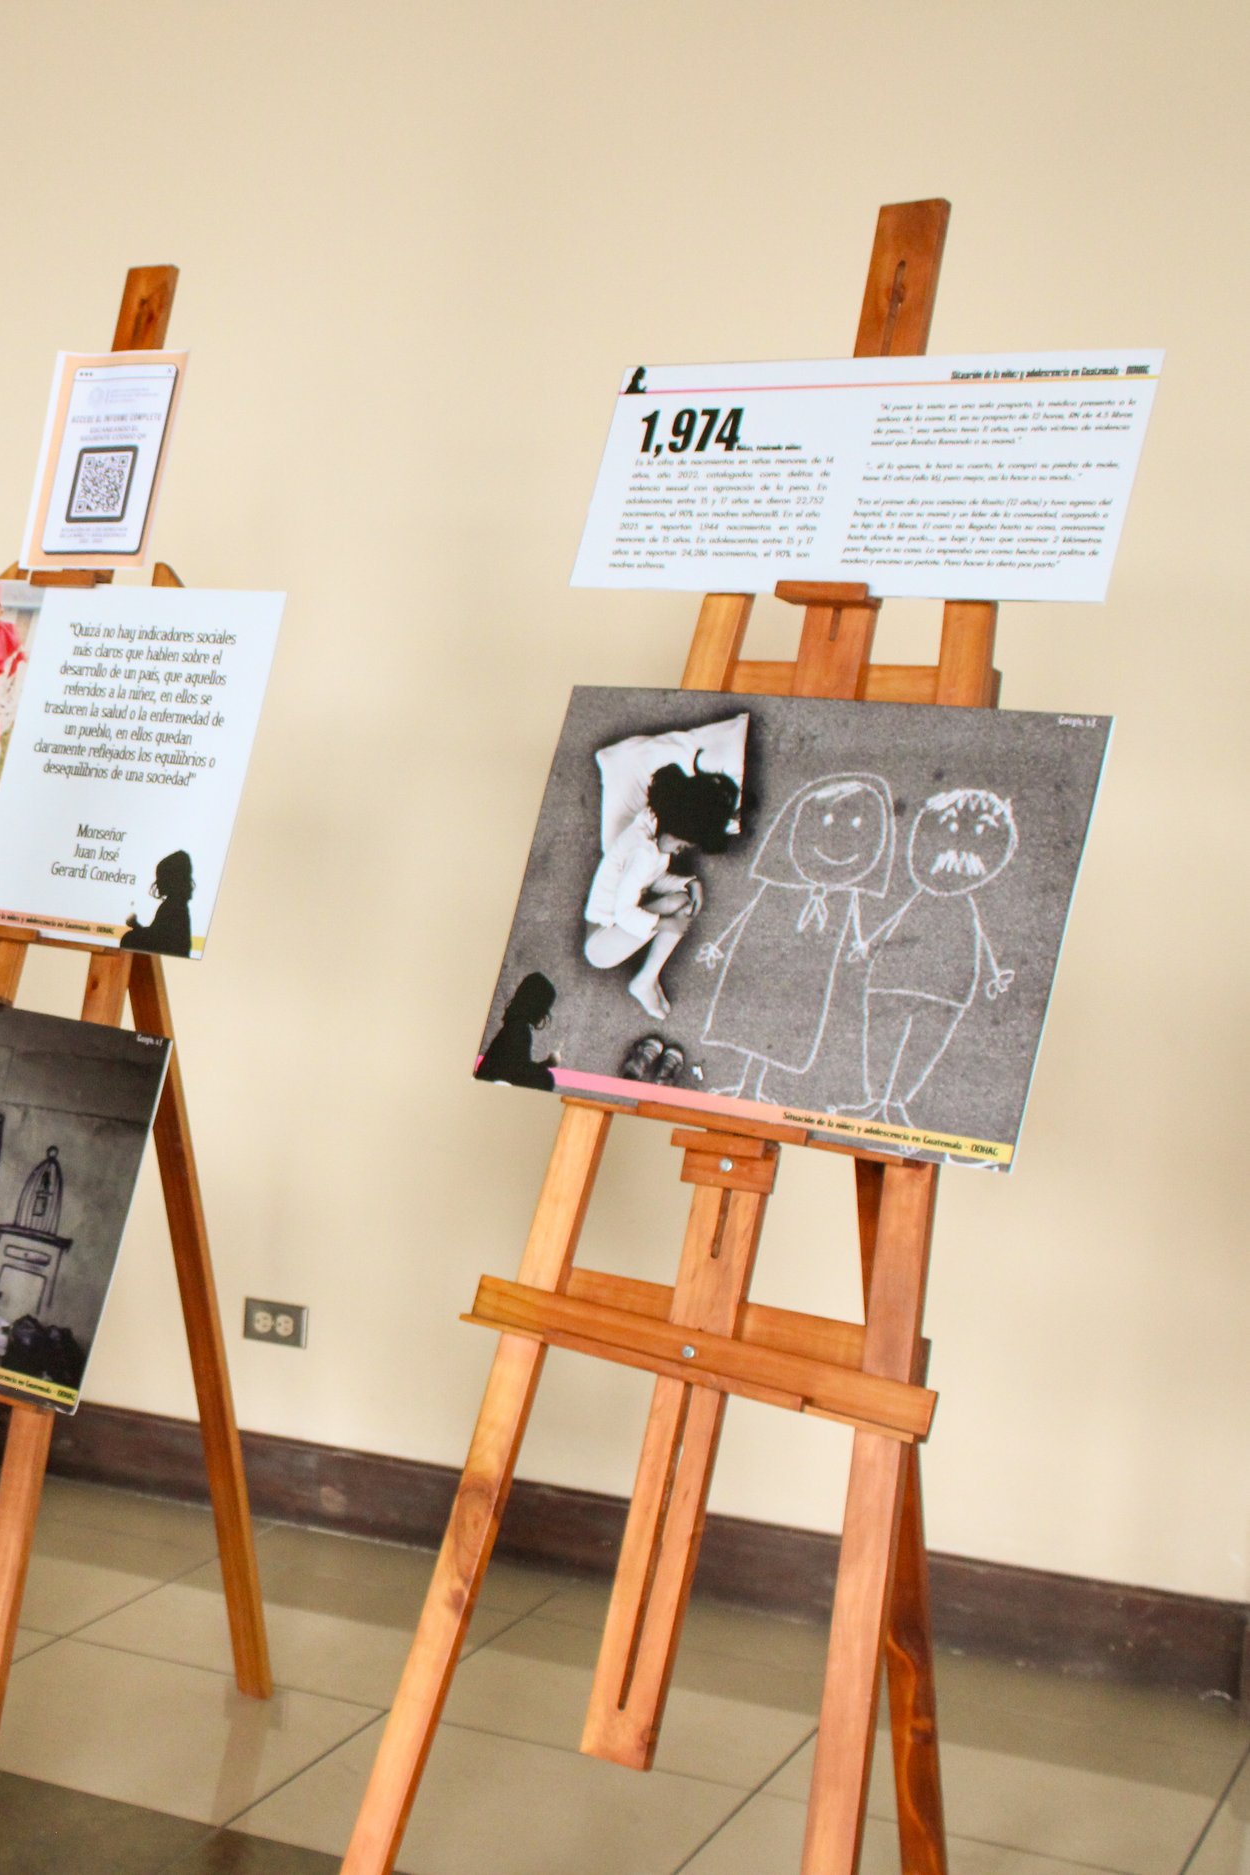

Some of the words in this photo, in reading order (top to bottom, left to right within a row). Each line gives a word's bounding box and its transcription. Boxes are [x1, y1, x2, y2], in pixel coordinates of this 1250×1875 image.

[1081, 367, 1119, 376] Guatemala
[640, 407, 744, 457] 1,974
[102, 627, 115, 638] no
[117, 624, 137, 642] hay
[137, 625, 194, 643] indicadores
[196, 629, 236, 645] sociales
[72, 643, 92, 657] más
[94, 643, 124, 659] claros
[125, 649, 144, 663] que
[145, 646, 179, 662] hablen
[181, 648, 210, 664] sobre
[212, 650, 223, 664] el
[59, 661, 108, 678] desarrollo
[109, 664, 122, 678] de
[123, 669, 137, 680] un
[137, 667, 160, 684] país,
[163, 671, 183, 685] que
[184, 670, 227, 687] aquellos
[63, 683, 107, 698] referidos
[108, 688, 115, 698] a
[116, 685, 126, 699] la
[128, 686, 156, 704] niñez,
[160, 691, 173, 702] en
[175, 688, 198, 704] ellos
[200, 694, 212, 705] se
[44, 701, 88, 716] traslucen
[89, 703, 99, 717] la
[101, 705, 129, 719] salud
[129, 710, 136, 720] o
[137, 707, 148, 721] la
[149, 709, 211, 726] enfermedad
[211, 712, 225, 727] de
[64, 725, 77, 736] un
[77, 723, 112, 741] pueblo,
[115, 728, 128, 740] en
[130, 726, 153, 742] ellos
[155, 729, 192, 746] quedan
[33, 739, 87, 756] claramente
[87, 744, 136, 762] reflejados
[137, 747, 153, 762] los
[154, 750, 207, 767] equilibrios
[208, 757, 216, 768] o
[43, 759, 109, 779] desequilibrios
[110, 765, 123, 780] de
[125, 771, 144, 782] una
[76, 824, 127, 842] Monseñor
[73, 843, 96, 859] Juan
[98, 846, 120, 862] José
[51, 861, 88, 879] Gerardi
[90, 866, 136, 885] Conedera
[783, 1112, 815, 1124] Situación
[816, 1118, 825, 1126] de
[835, 1123, 854, 1131] niñez
[863, 1127, 909, 1140] adolescencia
[923, 1136, 962, 1150] Guatemala
